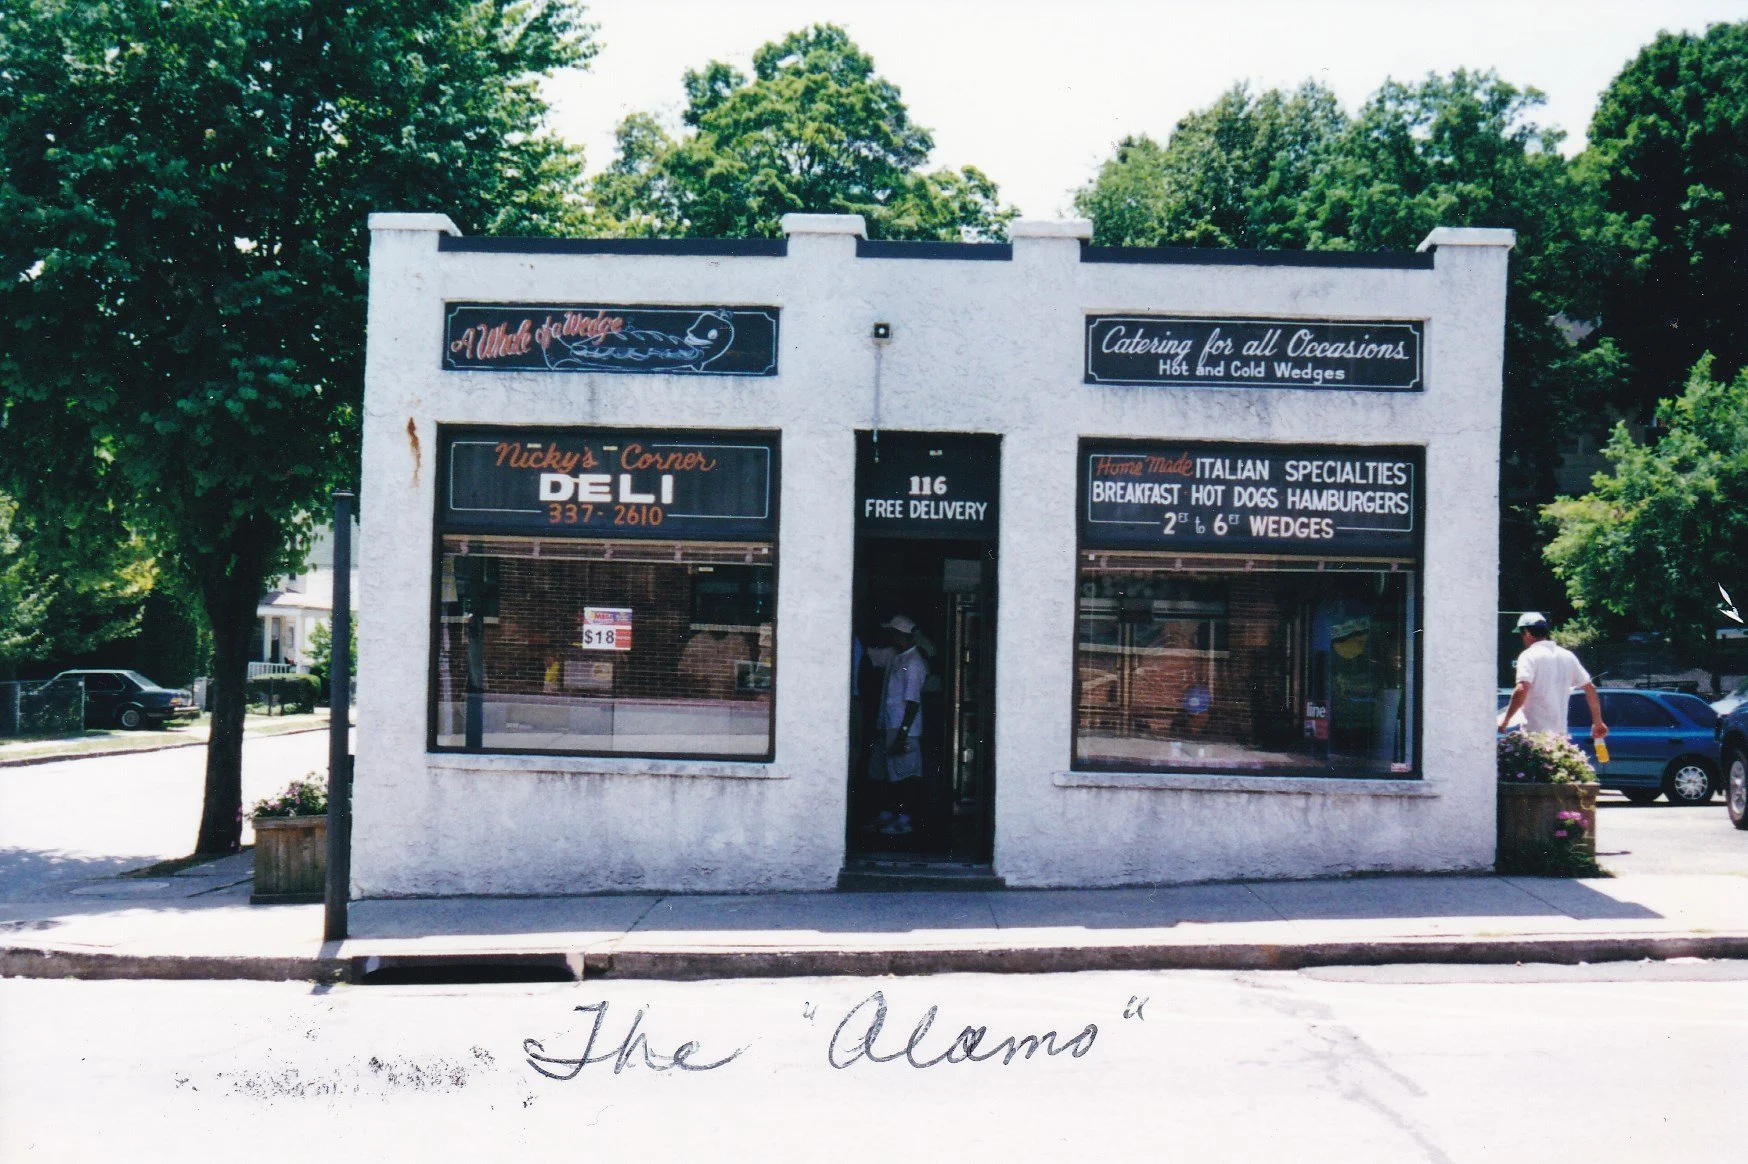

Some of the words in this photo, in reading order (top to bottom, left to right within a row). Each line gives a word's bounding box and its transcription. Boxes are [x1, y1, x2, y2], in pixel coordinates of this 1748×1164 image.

[451, 328, 476, 360] A
[477, 318, 532, 361] Whale
[535, 315, 552, 349] of
[551, 321, 563, 339] a
[563, 309, 624, 346] Wedge
[1102, 325, 1192, 366] Catering
[1197, 327, 1235, 369] for
[1242, 328, 1281, 357] all
[1287, 329, 1410, 361] Occasions
[1158, 360, 1190, 376] Hot
[1195, 359, 1226, 377] and
[1230, 360, 1266, 378] Cold
[1274, 362, 1346, 386] Wedges
[495, 442, 599, 474] Nicky's
[620, 443, 718, 473] Corner
[1096, 455, 1143, 477] Home
[1145, 451, 1195, 477] Made
[1195, 457, 1270, 482] ITALIAN
[1285, 460, 1408, 486] SPECIALTIES
[538, 472, 674, 505] DELI
[908, 475, 948, 495] 116
[1091, 480, 1182, 506] BREAKFAST
[1191, 484, 1226, 508] HOT
[1233, 485, 1280, 510] DOGS
[1286, 487, 1410, 515] HAMBURGERS
[865, 499, 904, 519] FREE
[909, 500, 988, 521] DELIVERY
[1195, 515, 1207, 535] to
[1249, 515, 1335, 539] WEDGES
[584, 628, 615, 645] $18
[523, 1000, 740, 1081] The
